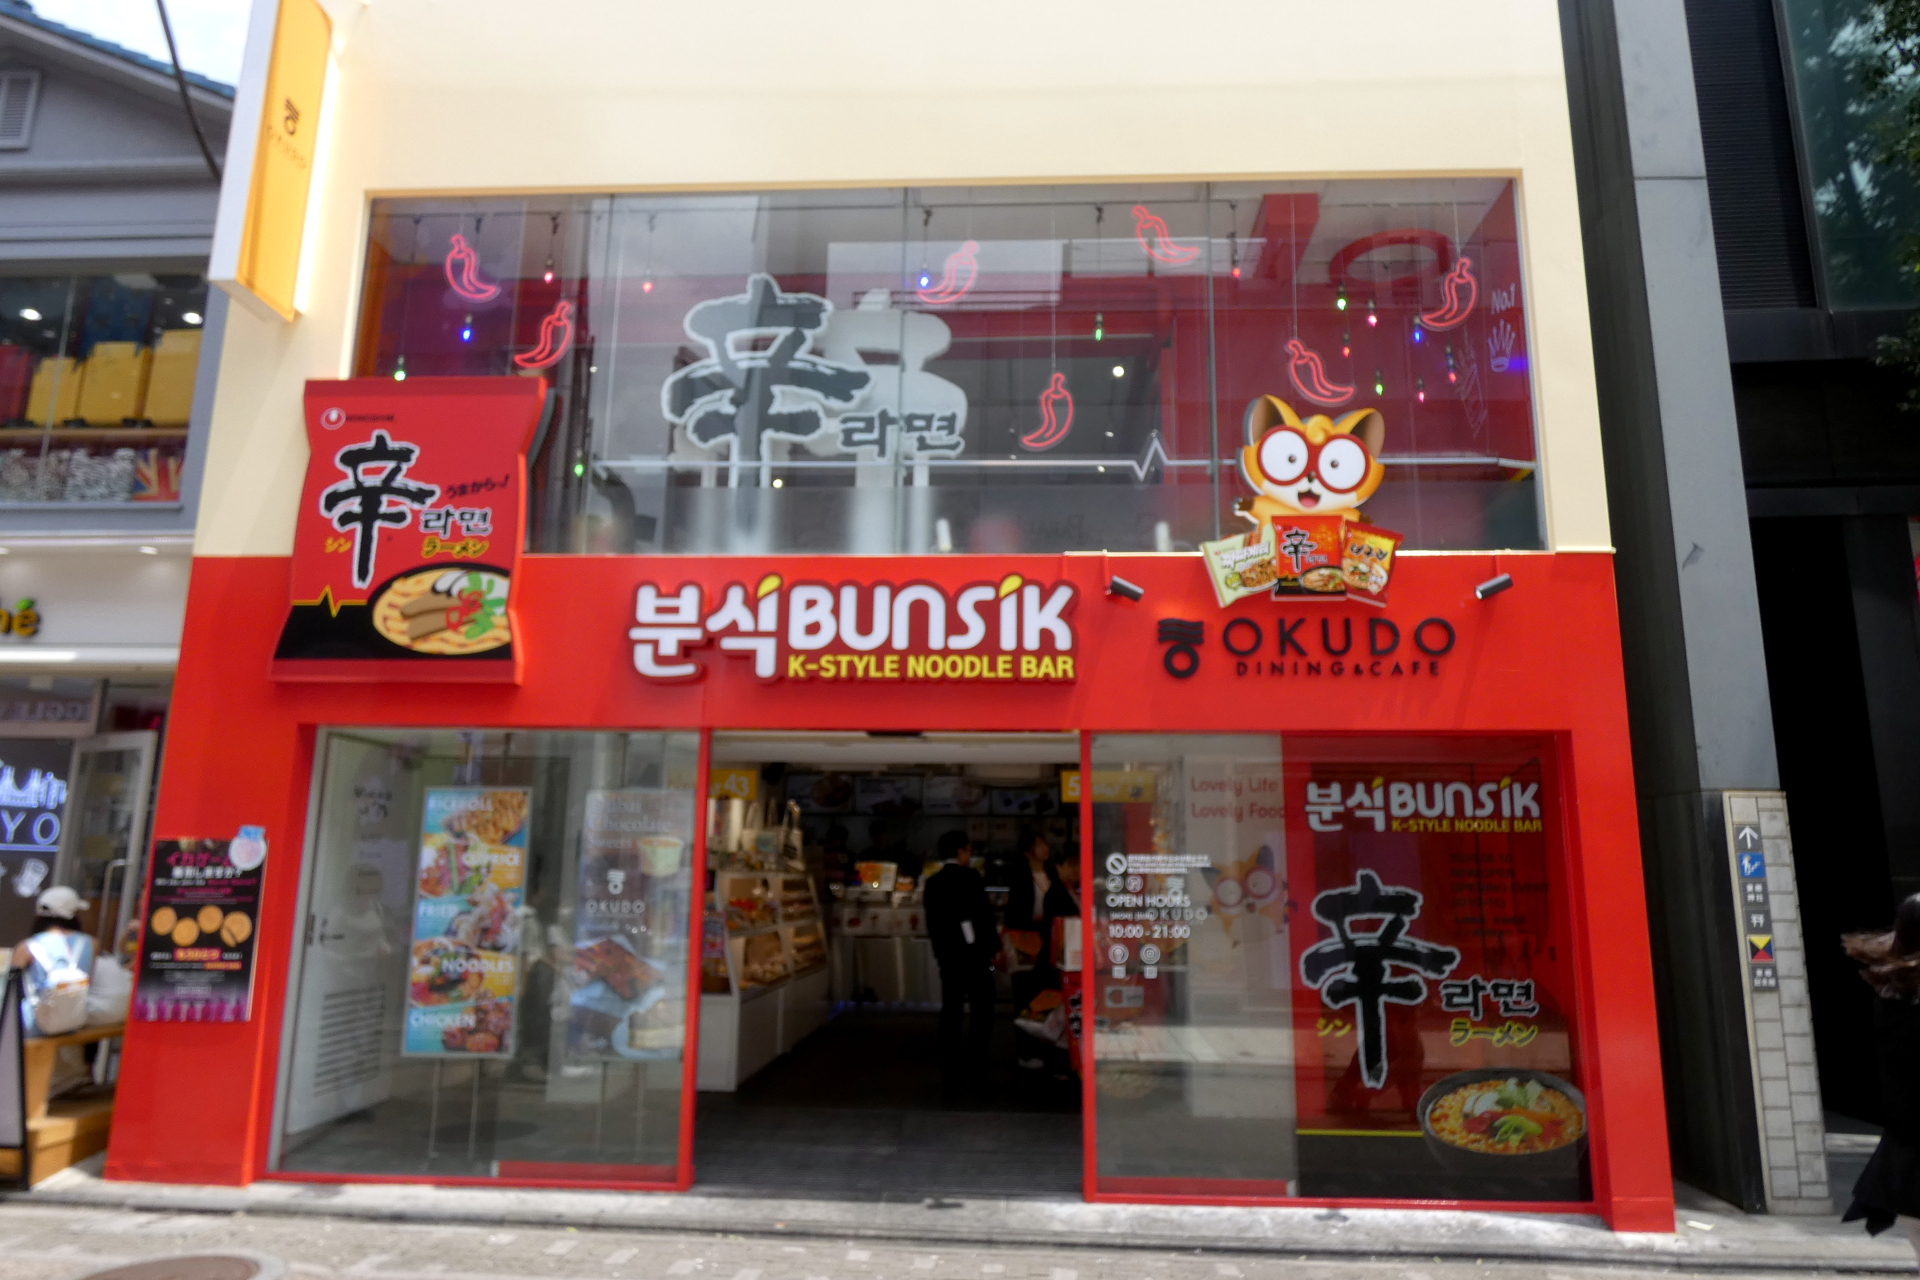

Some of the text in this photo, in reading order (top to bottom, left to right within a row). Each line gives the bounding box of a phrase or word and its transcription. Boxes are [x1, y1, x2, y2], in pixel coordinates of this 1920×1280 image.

[838, 409, 964, 459] 라면
[320, 429, 440, 589] 辛
[419, 505, 492, 539] 라면
[324, 536, 352, 553] シン
[421, 536, 489, 557] ラーメン
[1280, 527, 1317, 573] 辛
[628, 574, 782, 679] 분식
[1222, 617, 1456, 656] OKUDO
[788, 655, 1075, 679] K-STYLE NOODLE BAR
[1191, 777, 1278, 797] Lovely Life
[1192, 803, 1243, 823] Lovely
[1305, 776, 1386, 832] 분식
[1392, 819, 1542, 832] K-STYLE NOODLE BAR
[585, 898, 646, 914] OKUDO
[1105, 894, 1191, 908] OPEN HOURS
[1108, 924, 1144, 938] 10:00
[1151, 924, 1191, 938] 21:00
[442, 957, 514, 973] NOODLES
[1300, 868, 1461, 1089] 辛
[1441, 975, 1539, 1021] 라면
[410, 1013, 476, 1028] CHICKEN
[1315, 1018, 1352, 1037] シン
[1449, 1018, 1539, 1046] ラーメン
